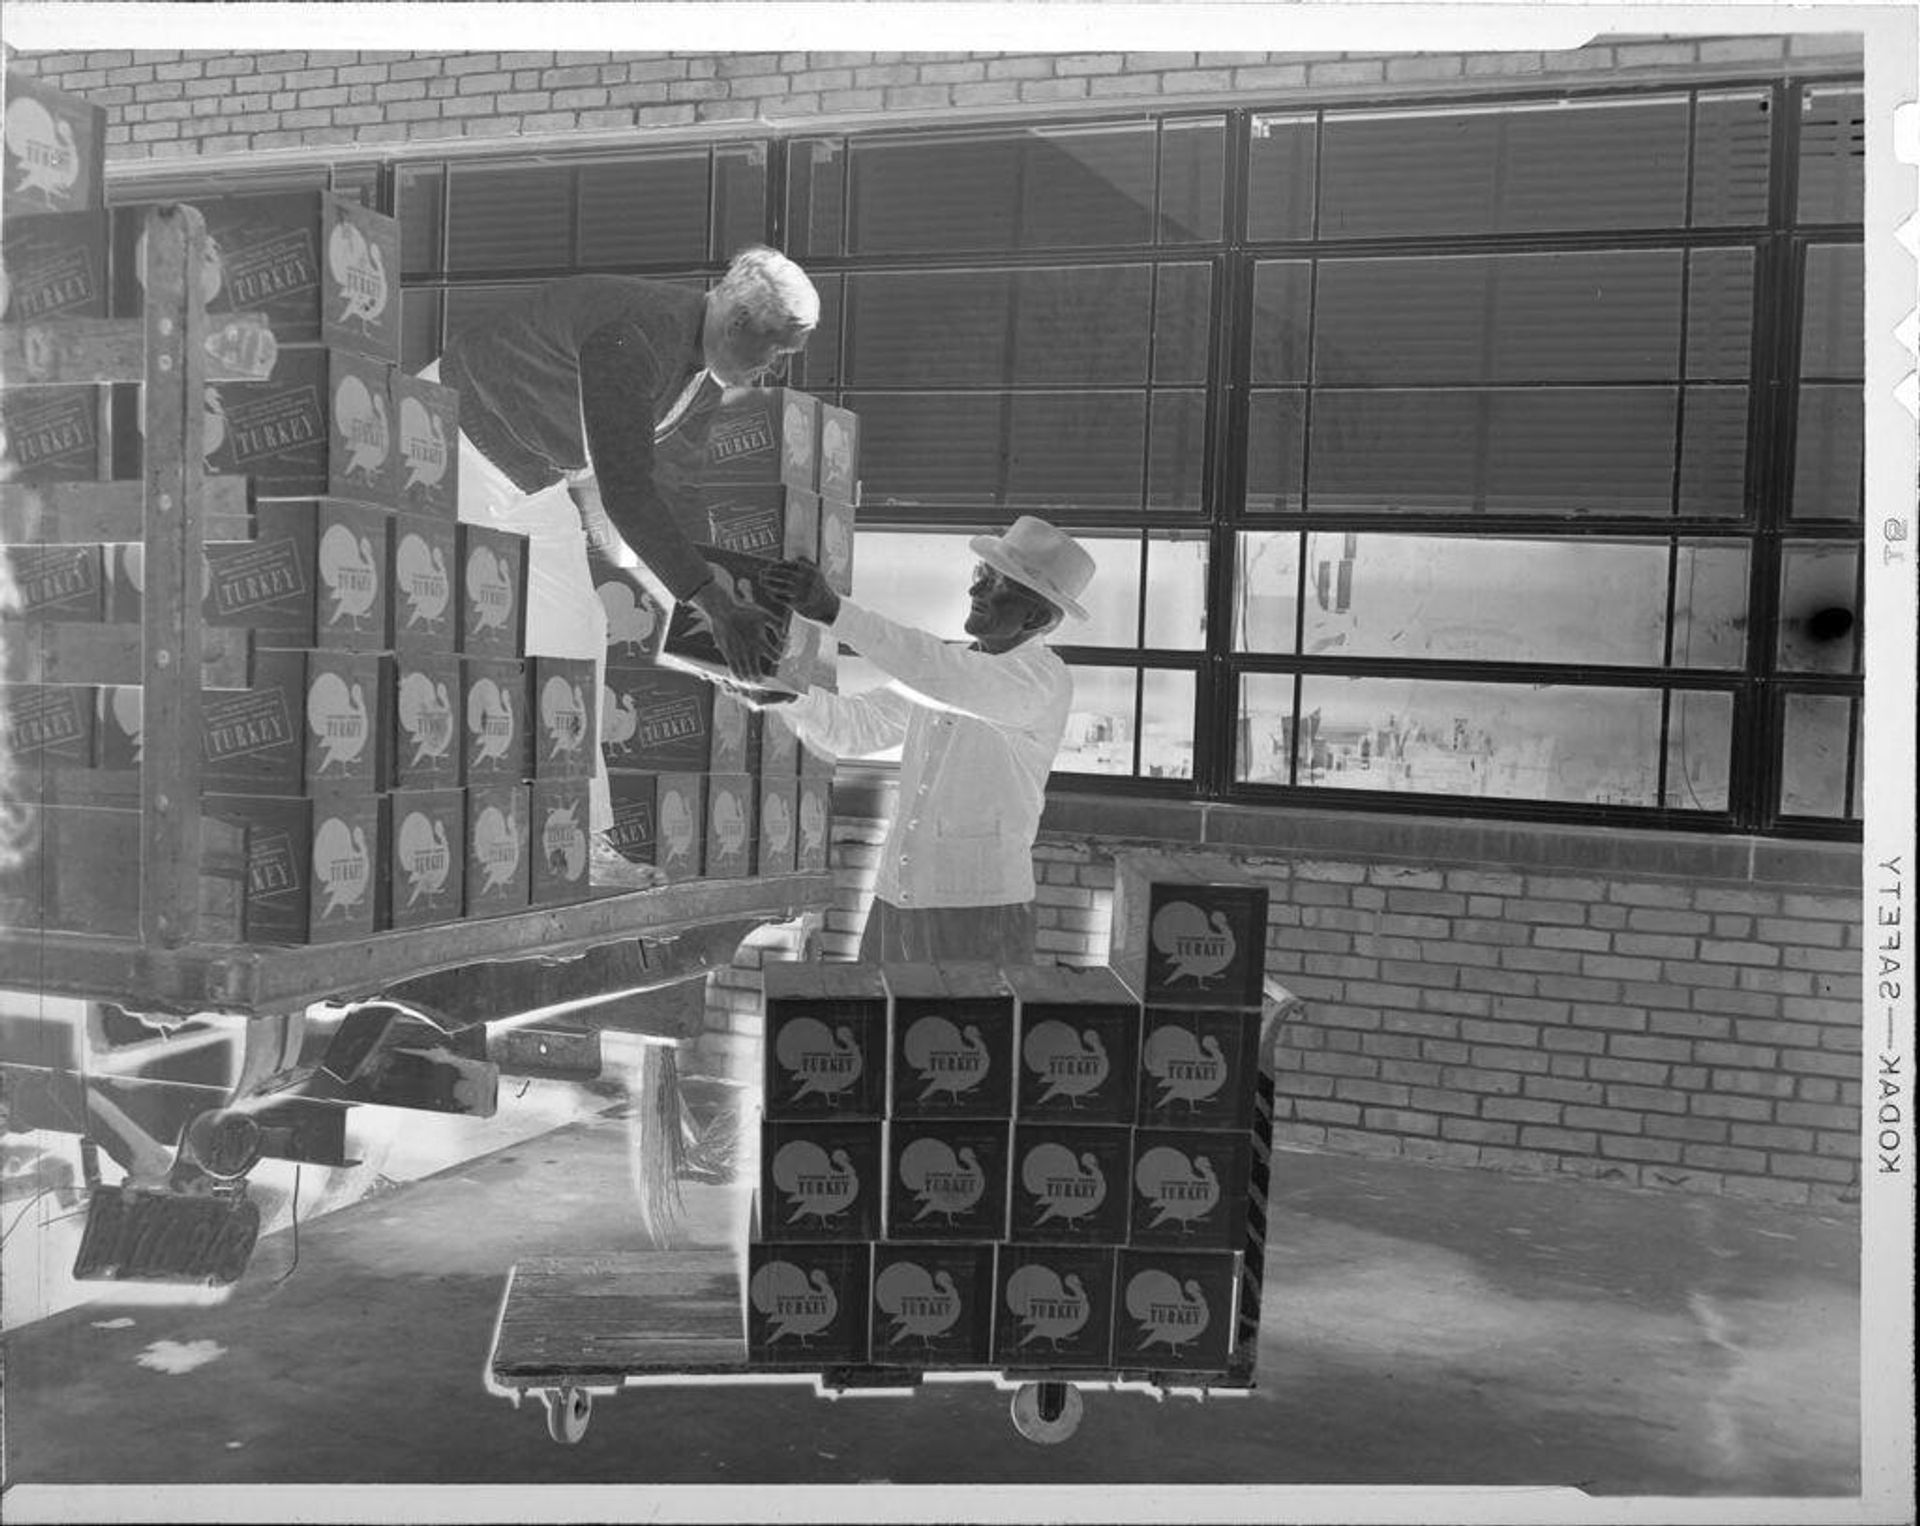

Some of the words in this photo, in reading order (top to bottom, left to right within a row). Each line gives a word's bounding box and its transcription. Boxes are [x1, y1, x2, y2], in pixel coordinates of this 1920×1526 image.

[235, 259, 306, 301] TURKEY
[236, 414, 313, 454] TURKEY
[714, 431, 767, 458] TURKEY
[222, 567, 295, 605] TURKEY
[210, 717, 281, 753] TURKEY
[642, 716, 696, 742] TURKEY
[801, 1057, 854, 1072] TURKEY
[929, 1057, 980, 1071] TURKEY
[1048, 1061, 1100, 1075] TURKEY
[1168, 1065, 1218, 1080] TURKEY
[797, 1181, 849, 1196] TURKEY
[1046, 1182, 1097, 1198] TURKEY
[1160, 1185, 1212, 1200] TURKEY
[776, 1300, 827, 1315] TURKEY
[901, 1301, 952, 1316] TURKEY
[1029, 1304, 1080, 1319] TURKEY
[1149, 1309, 1200, 1324] TURKEY
